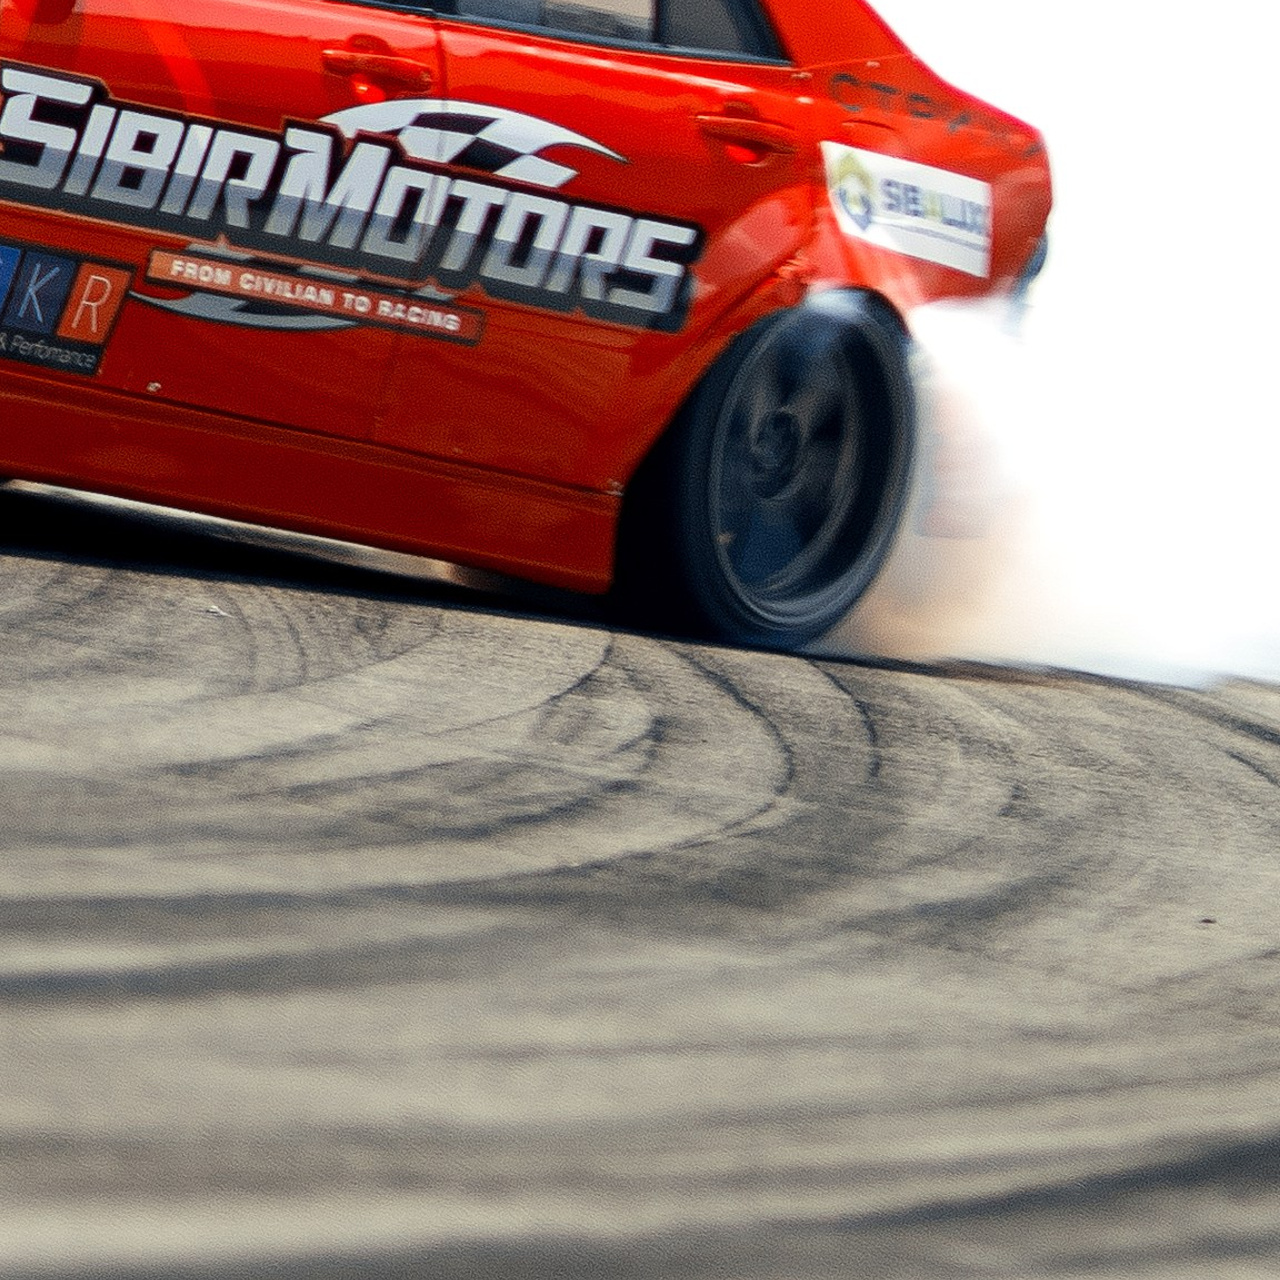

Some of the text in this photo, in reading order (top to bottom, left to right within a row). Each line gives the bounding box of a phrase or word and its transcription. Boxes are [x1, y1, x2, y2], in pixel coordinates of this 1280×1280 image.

[170, 260, 462, 332] FROM CIVILIAN TO RACING
